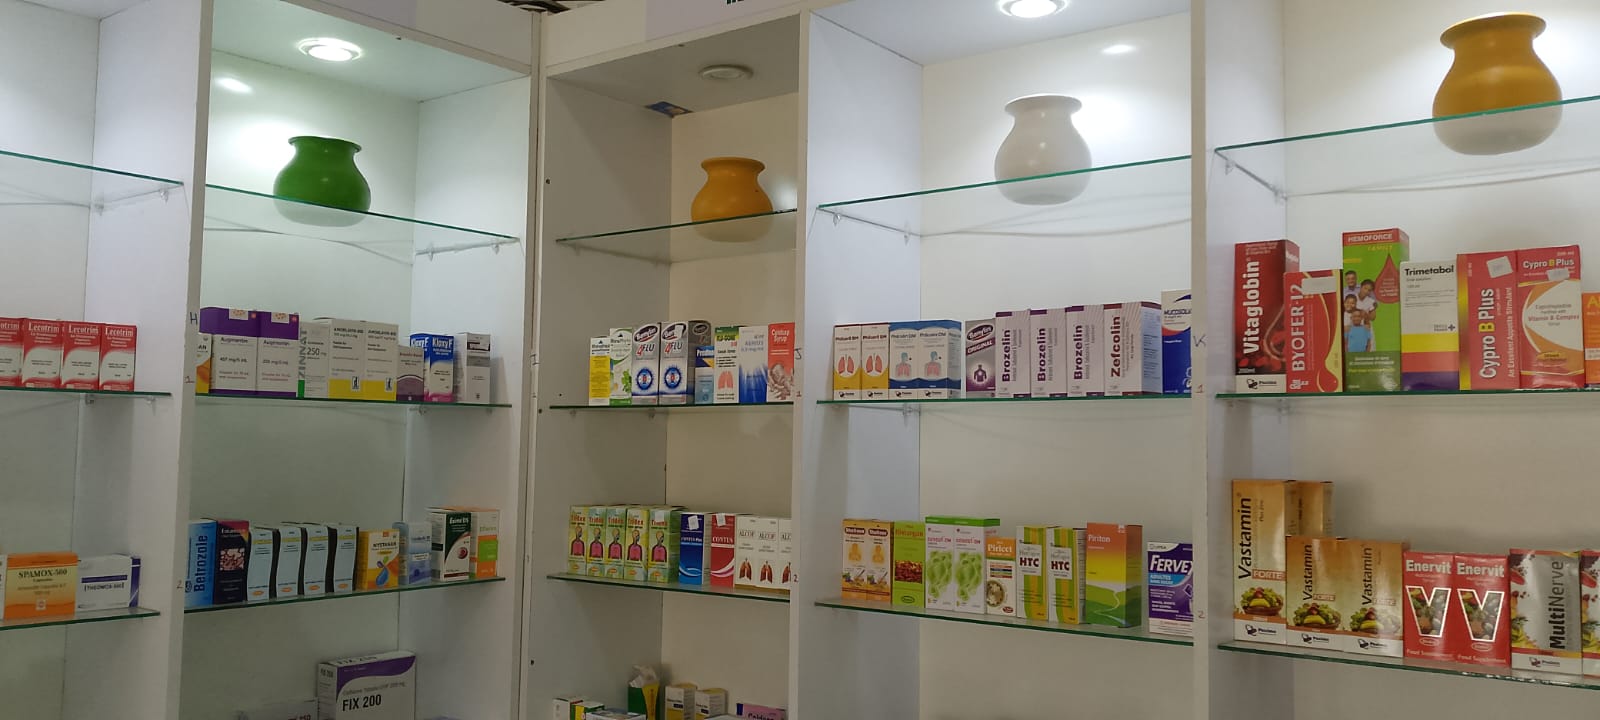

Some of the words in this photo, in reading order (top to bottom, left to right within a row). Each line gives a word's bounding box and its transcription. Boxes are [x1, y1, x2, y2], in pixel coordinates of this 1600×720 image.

[1347, 233, 1394, 243] HEMOFORCE
[1404, 265, 1454, 276] Trimetabol
[1522, 260, 1548, 270] Cypro
[1556, 258, 1575, 267] Plus
[1243, 261, 1263, 354] Vitaglobin
[1478, 288, 1495, 320] Plus
[28, 322, 60, 333] Lecotrim
[68, 325, 99, 335] Lecotrim
[105, 327, 134, 337] Lecotrim
[1479, 322, 1496, 332] B
[1037, 328, 1046, 382] Brozelin
[1073, 325, 1083, 380] Brozelin
[1110, 316, 1121, 378] Zefcolin
[1001, 329, 1011, 382] Brozelin
[1479, 335, 1500, 379] Cypro
[1238, 498, 1252, 579] Vastamin
[1020, 557, 1039, 567] HTC
[1051, 561, 1070, 571] HTC
[1405, 559, 1451, 574] Enervit
[1457, 562, 1504, 578] Enervit
[1253, 571, 1283, 580] FORTE
[1302, 544, 1313, 601] Vastamin
[1361, 547, 1373, 606] Vastamin
[1547, 561, 1566, 650] MultiNerve
[342, 698, 360, 711] FIX
[362, 694, 382, 709] 200
